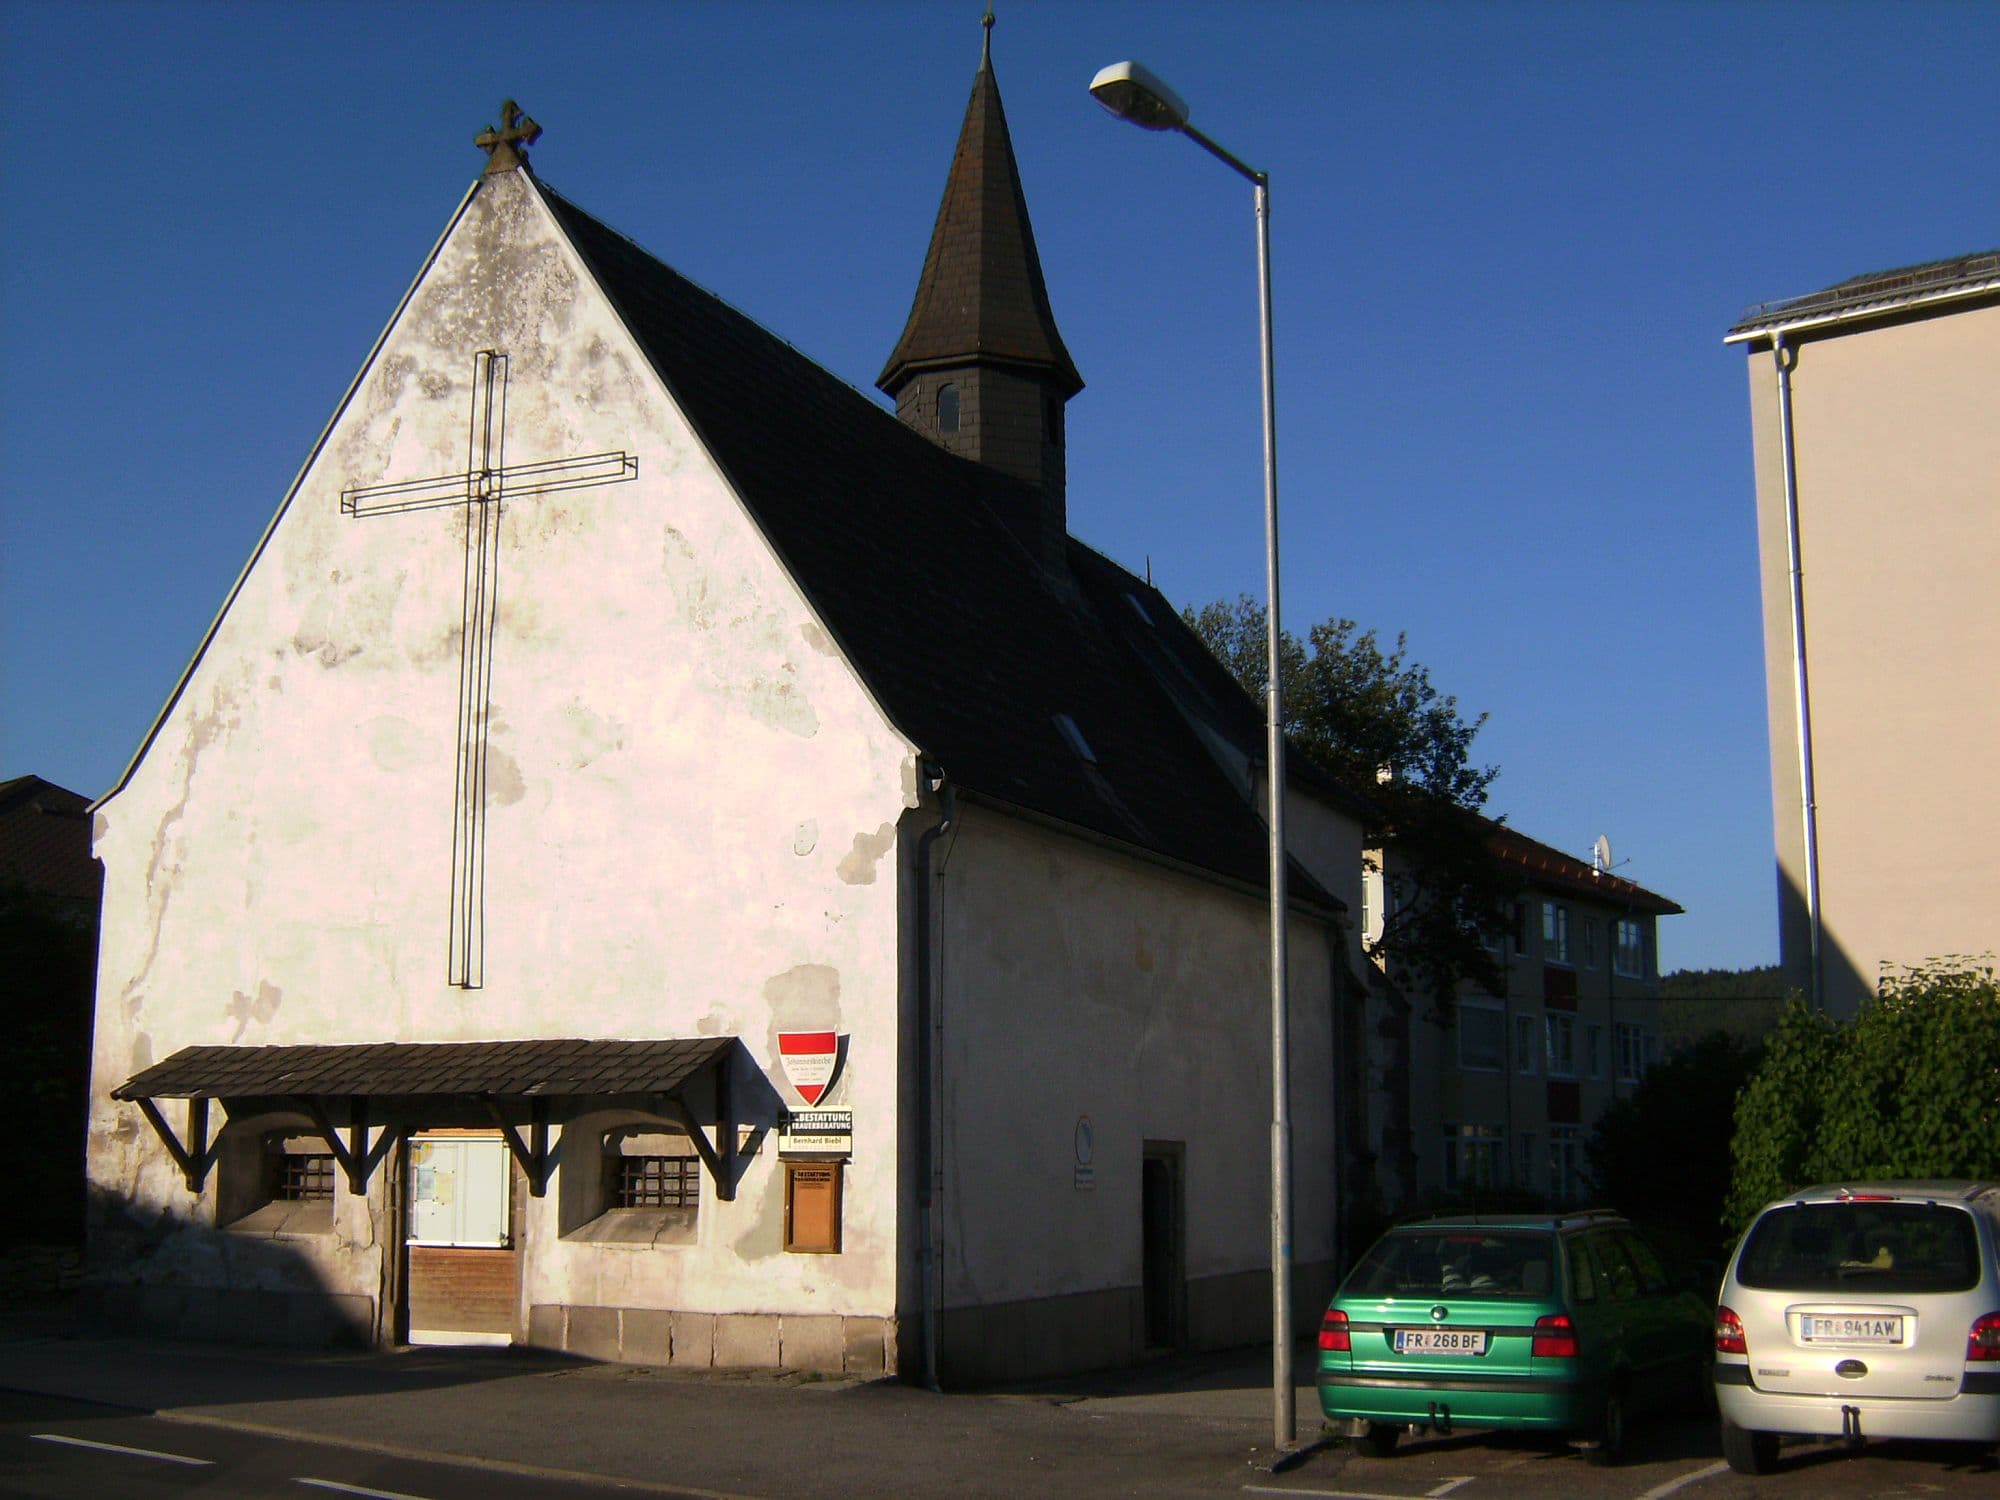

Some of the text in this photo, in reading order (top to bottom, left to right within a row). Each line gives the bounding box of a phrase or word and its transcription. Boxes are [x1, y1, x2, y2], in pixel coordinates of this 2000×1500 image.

[799, 1113, 851, 1122] BESTATTUNG
[792, 1122, 851, 1130] TRAUERBERATUNG
[793, 1137, 823, 1145] Bernhard
[1814, 1320, 1833, 1335] FR
[1406, 1333, 1480, 1349] FR 268 BF
